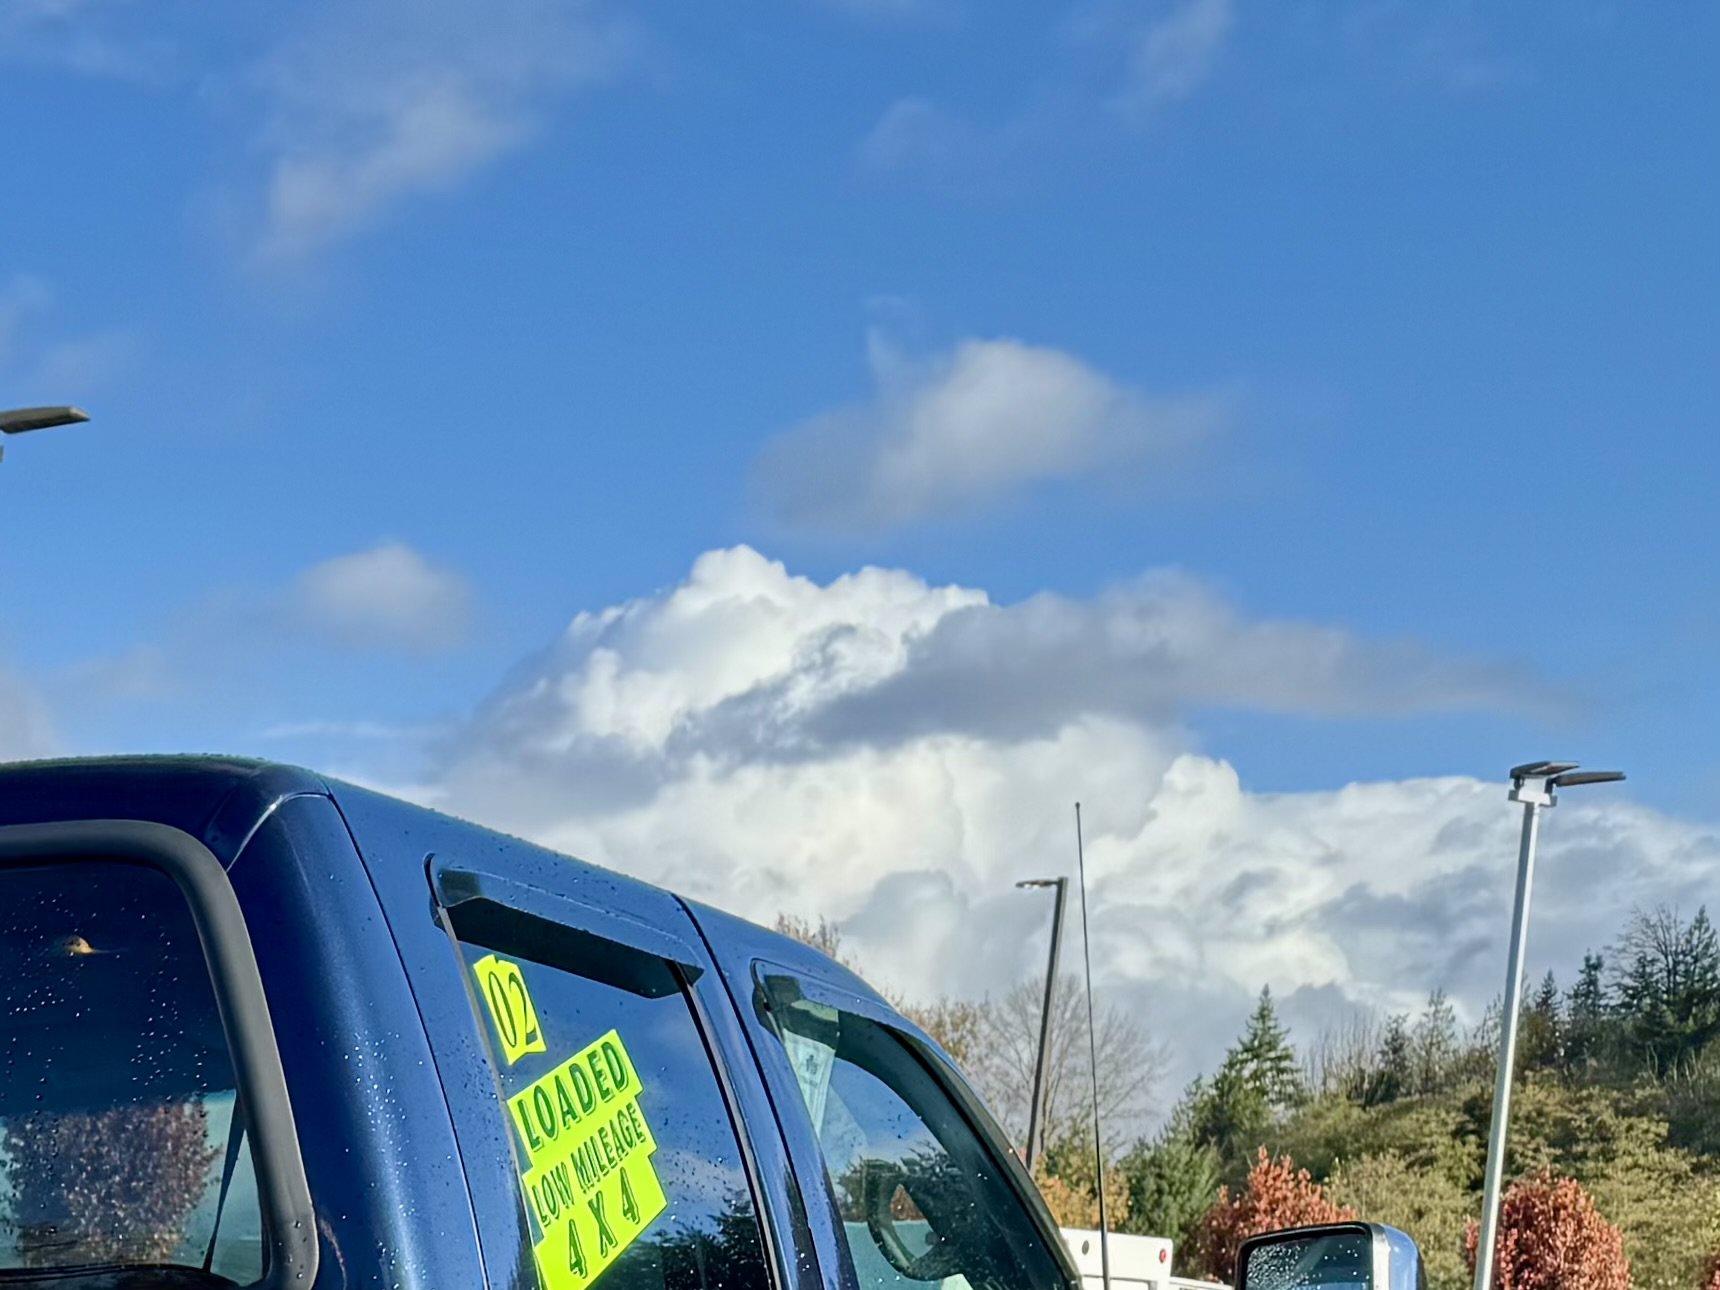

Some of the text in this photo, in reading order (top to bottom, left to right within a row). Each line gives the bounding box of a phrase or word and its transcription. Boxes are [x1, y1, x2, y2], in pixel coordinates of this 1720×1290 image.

[488, 970, 538, 1048] 02
[517, 1041, 630, 1151] LOADED
[532, 1102, 646, 1228] LOW MILEAGE
[569, 1166, 640, 1279] 4 X 4
